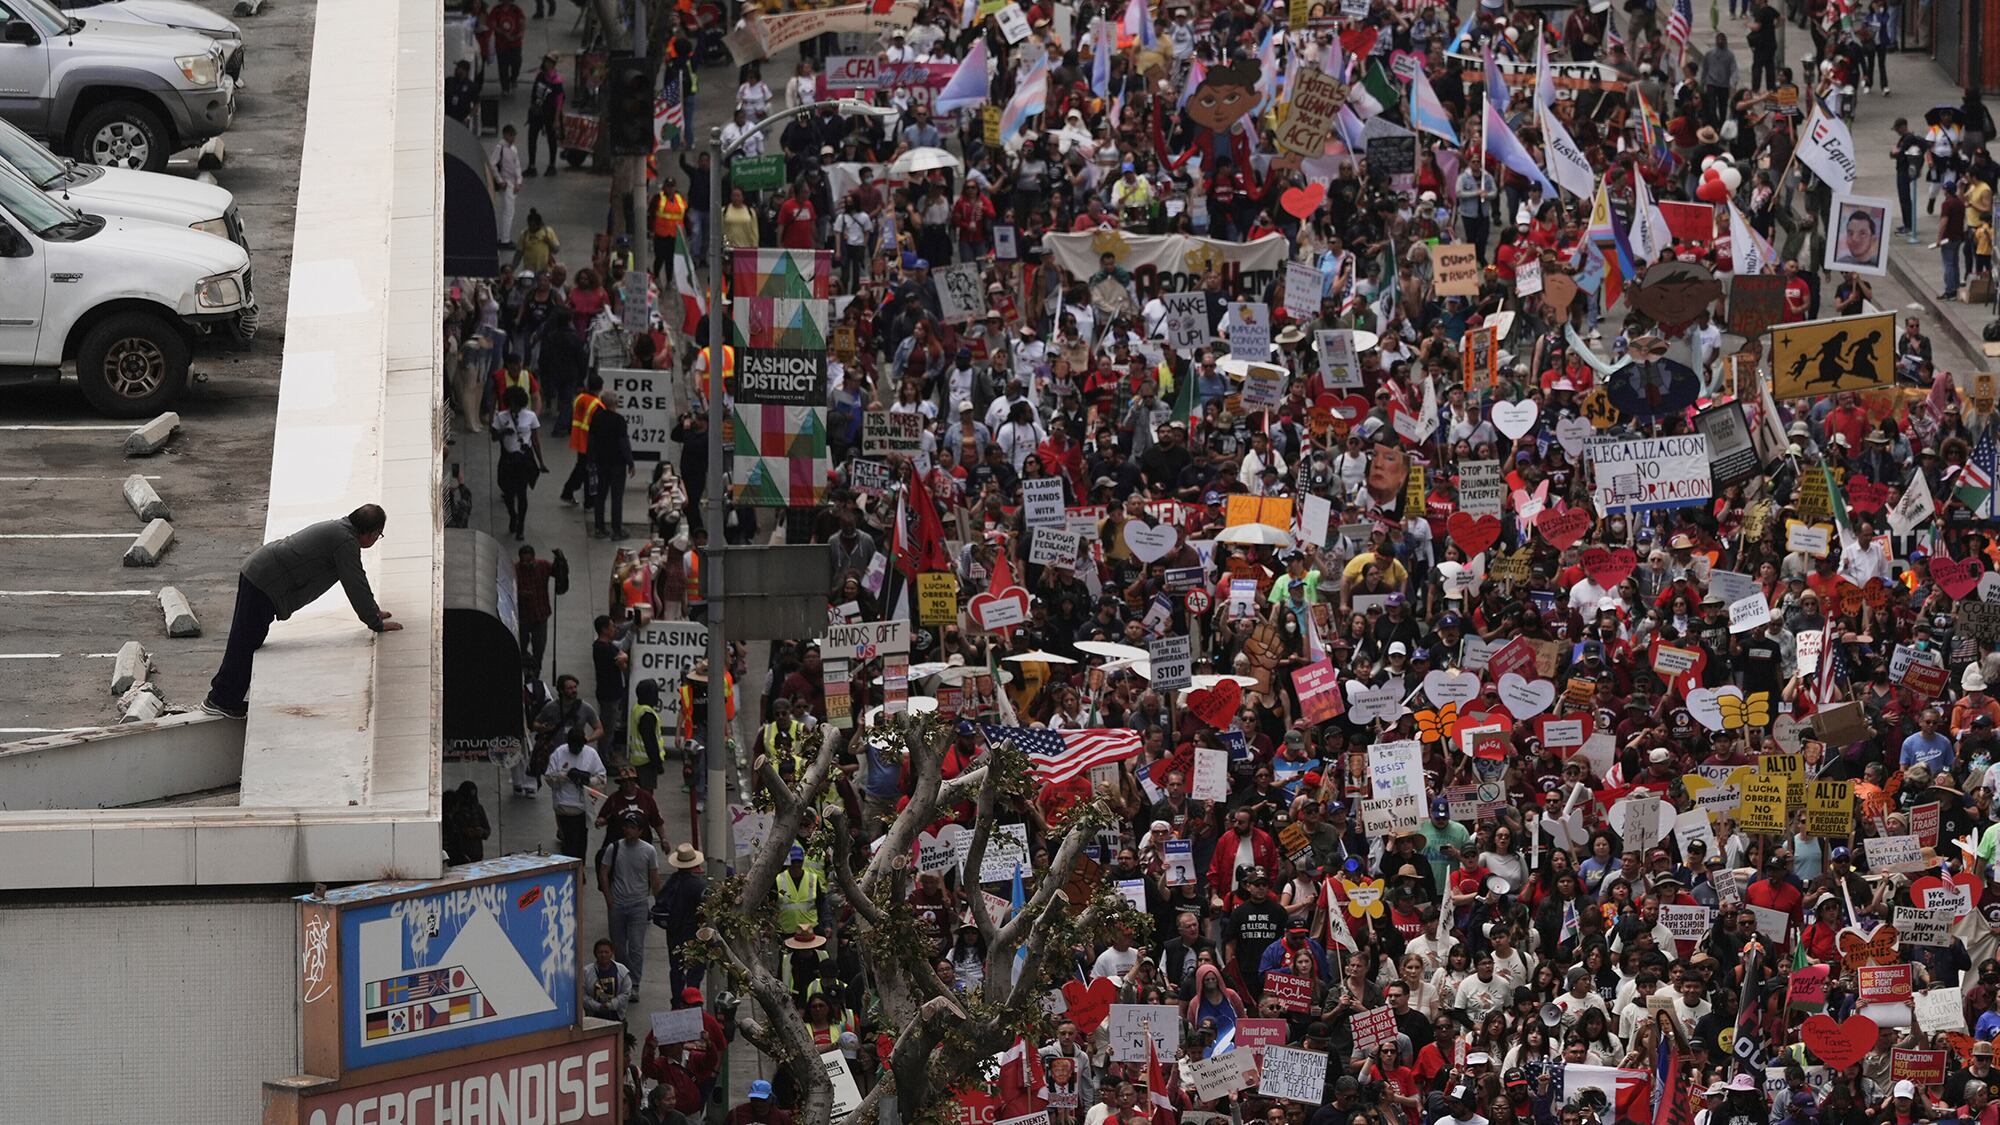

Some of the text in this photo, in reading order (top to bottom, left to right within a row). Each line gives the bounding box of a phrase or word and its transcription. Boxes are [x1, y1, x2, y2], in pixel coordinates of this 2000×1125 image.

[845, 59, 876, 79] CFA
[1297, 73, 1344, 101] HOTELS
[1298, 111, 1322, 129] YOUR
[1283, 125, 1324, 152] ACT!
[1822, 138, 1856, 182] Equity
[1440, 254, 1475, 267] DUMP
[1439, 269, 1476, 283] TRUMP
[1163, 296, 1208, 317] WAKE
[1231, 326, 1267, 336] IMPEACH
[1177, 330, 1203, 347] UP!
[1231, 336, 1267, 346] CONVICT
[1232, 346, 1265, 356] REMOVE
[743, 356, 817, 374] FASHION
[613, 378, 653, 393] FOR
[743, 373, 817, 391] DISTRICT
[616, 395, 667, 410] EASE
[867, 414, 885, 425] MIS
[1594, 438, 1705, 464] LEGALIZACION
[855, 463, 880, 477] FREE
[1460, 465, 1500, 476] STOP THE
[1636, 461, 1660, 480] NO
[1023, 480, 1060, 490] LA LABOR
[1460, 478, 1500, 489] BILLIONAIRE
[1027, 492, 1060, 503] STANDS
[1461, 489, 1500, 500] TAKEOVER
[1603, 479, 1712, 505] DORTACION
[1034, 506, 1055, 514] WITH
[1037, 530, 1075, 545] DEVOUR
[1189, 597, 1207, 607] ICE
[1733, 607, 1764, 623] FAMILIES
[637, 631, 709, 648] LEASING
[829, 624, 900, 648] HANDS OFF
[1151, 638, 1188, 650] FULL RIGHTS
[856, 644, 876, 659] US
[1158, 648, 1168, 656] FOR
[1152, 653, 1189, 664] IMMIGRANTS
[1157, 665, 1186, 679] STOP
[827, 696, 848, 707] FREE
[1479, 740, 1501, 751] MAGA
[1374, 762, 1405, 775] RESIST
[1766, 756, 1796, 773] ALTO
[1748, 785, 1779, 793] LUCHA
[1815, 783, 1847, 799] ALTO
[1363, 795, 1416, 811] HANDS OFF
[1697, 791, 1740, 805] Resiste!
[1745, 794, 1782, 803] OBRERA
[1820, 800, 1839, 809] A LAS
[1754, 805, 1770, 813] NO
[1912, 810, 1937, 820] PROTECT
[1368, 816, 1418, 831] EDUCATION
[1815, 817, 1849, 825] REDADAS
[1912, 818, 1937, 829] TRANS
[1810, 824, 1846, 833] RACISTAS
[920, 846, 935, 855] We
[921, 848, 955, 864] Belong
[922, 858, 948, 871] Here!
[1868, 852, 1921, 867] IMMIGRANTS
[1928, 891, 1944, 899] We
[1928, 896, 1964, 908] Belong
[1660, 913, 1705, 921] NO BORDERS
[1896, 907, 1935, 920] PROTECT
[1679, 921, 1705, 929] RIGHTS
[1691, 928, 1705, 936] OUR
[1899, 932, 1934, 942] IGHTS!
[1849, 941, 1886, 953] PROTECT
[1849, 947, 1890, 961] FAMILIES
[1861, 969, 1905, 979] ONE STRUGGLE
[1267, 974, 1311, 988] FUND CARE
[1874, 978, 1893, 986] FIGHT
[1861, 987, 1892, 995] WORKERS
[1127, 1010, 1158, 1027] Fight
[1354, 1012, 1387, 1030] SOME CUTS
[1242, 1027, 1279, 1037] Fund Care.
[1358, 1020, 1392, 1037] DON'T HEAL
[1133, 1039, 1165, 1049] NT
[1254, 1037, 1266, 1045] not
[1264, 1046, 1280, 1059] ALL
[1895, 1052, 1934, 1063] EDUCATION
[1264, 1059, 1326, 1080] DESERVE TO LIVE
[1894, 1060, 1909, 1069] NOT
[1200, 1064, 1237, 1080] Migrantes
[1263, 1068, 1316, 1087] WITH RESPECT
[1894, 1068, 1940, 1078] DEPORTATION
[307, 1049, 610, 1125] RCHANDISE
[1262, 1081, 1322, 1100] AND HEALTH
